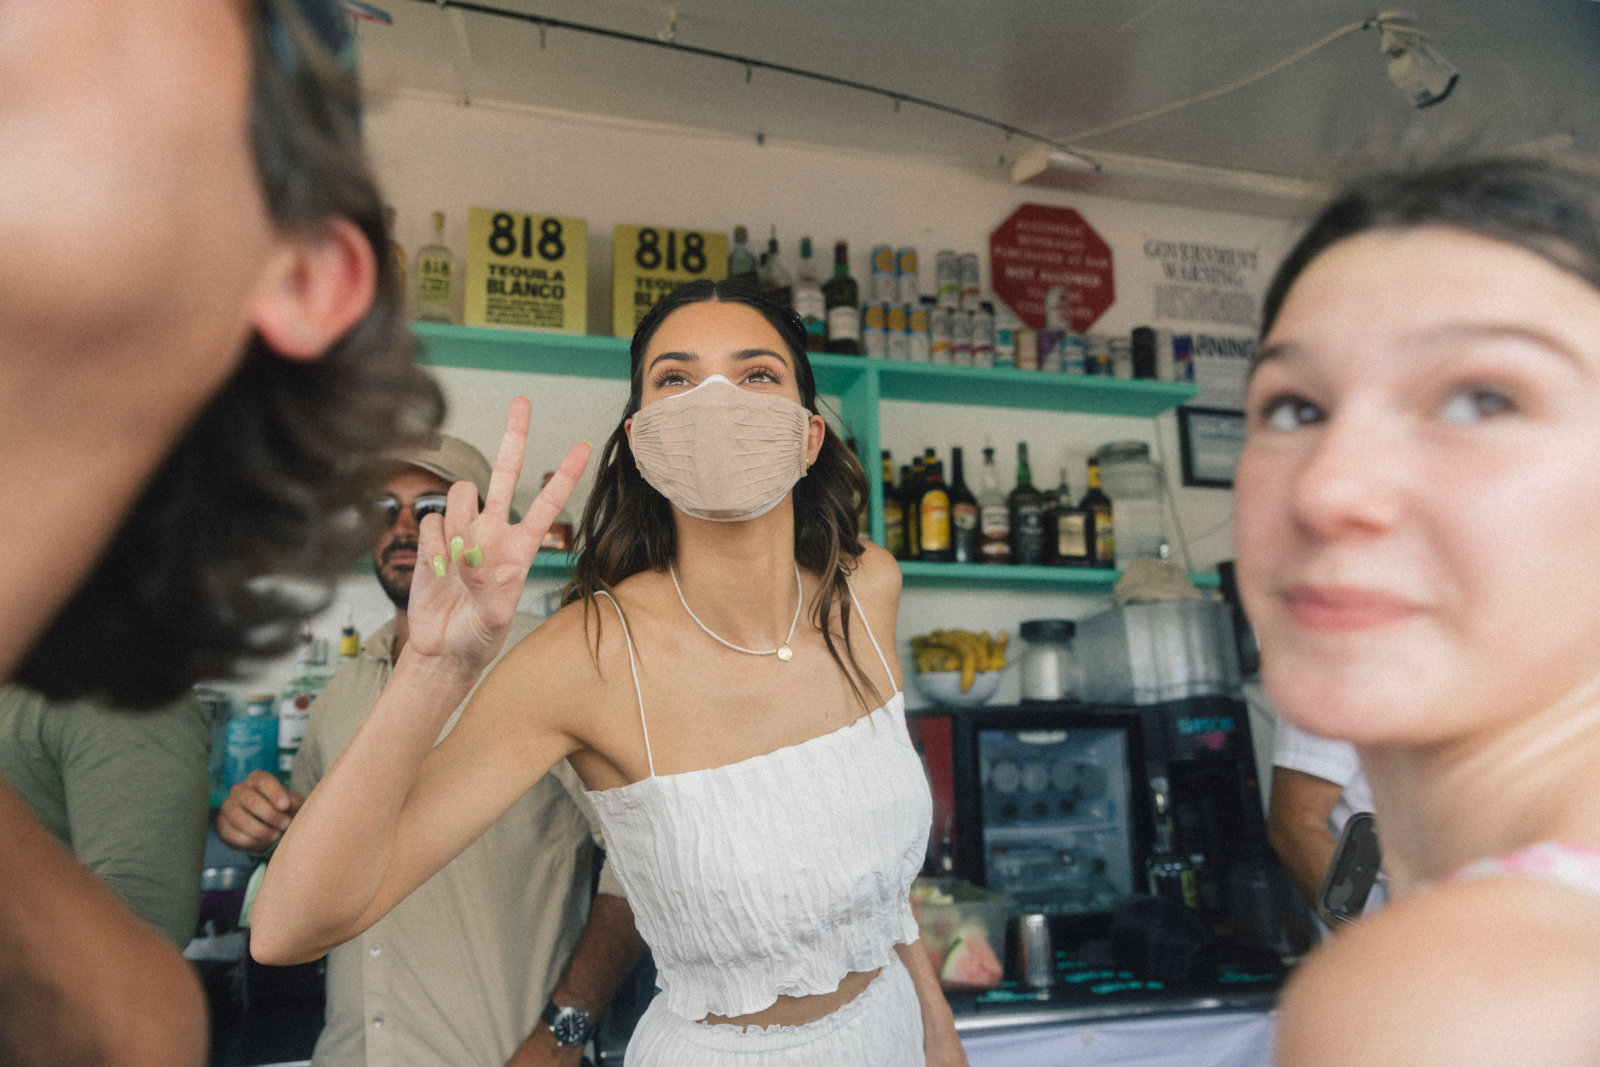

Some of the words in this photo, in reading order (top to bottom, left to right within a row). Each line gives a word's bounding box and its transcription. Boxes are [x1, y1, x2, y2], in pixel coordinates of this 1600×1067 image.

[488, 211, 565, 261] 818
[636, 228, 707, 274] 818
[1143, 240, 1258, 271] GOVERNMENT
[488, 264, 565, 281] TEQUILA
[487, 279, 565, 300] BLANCO
